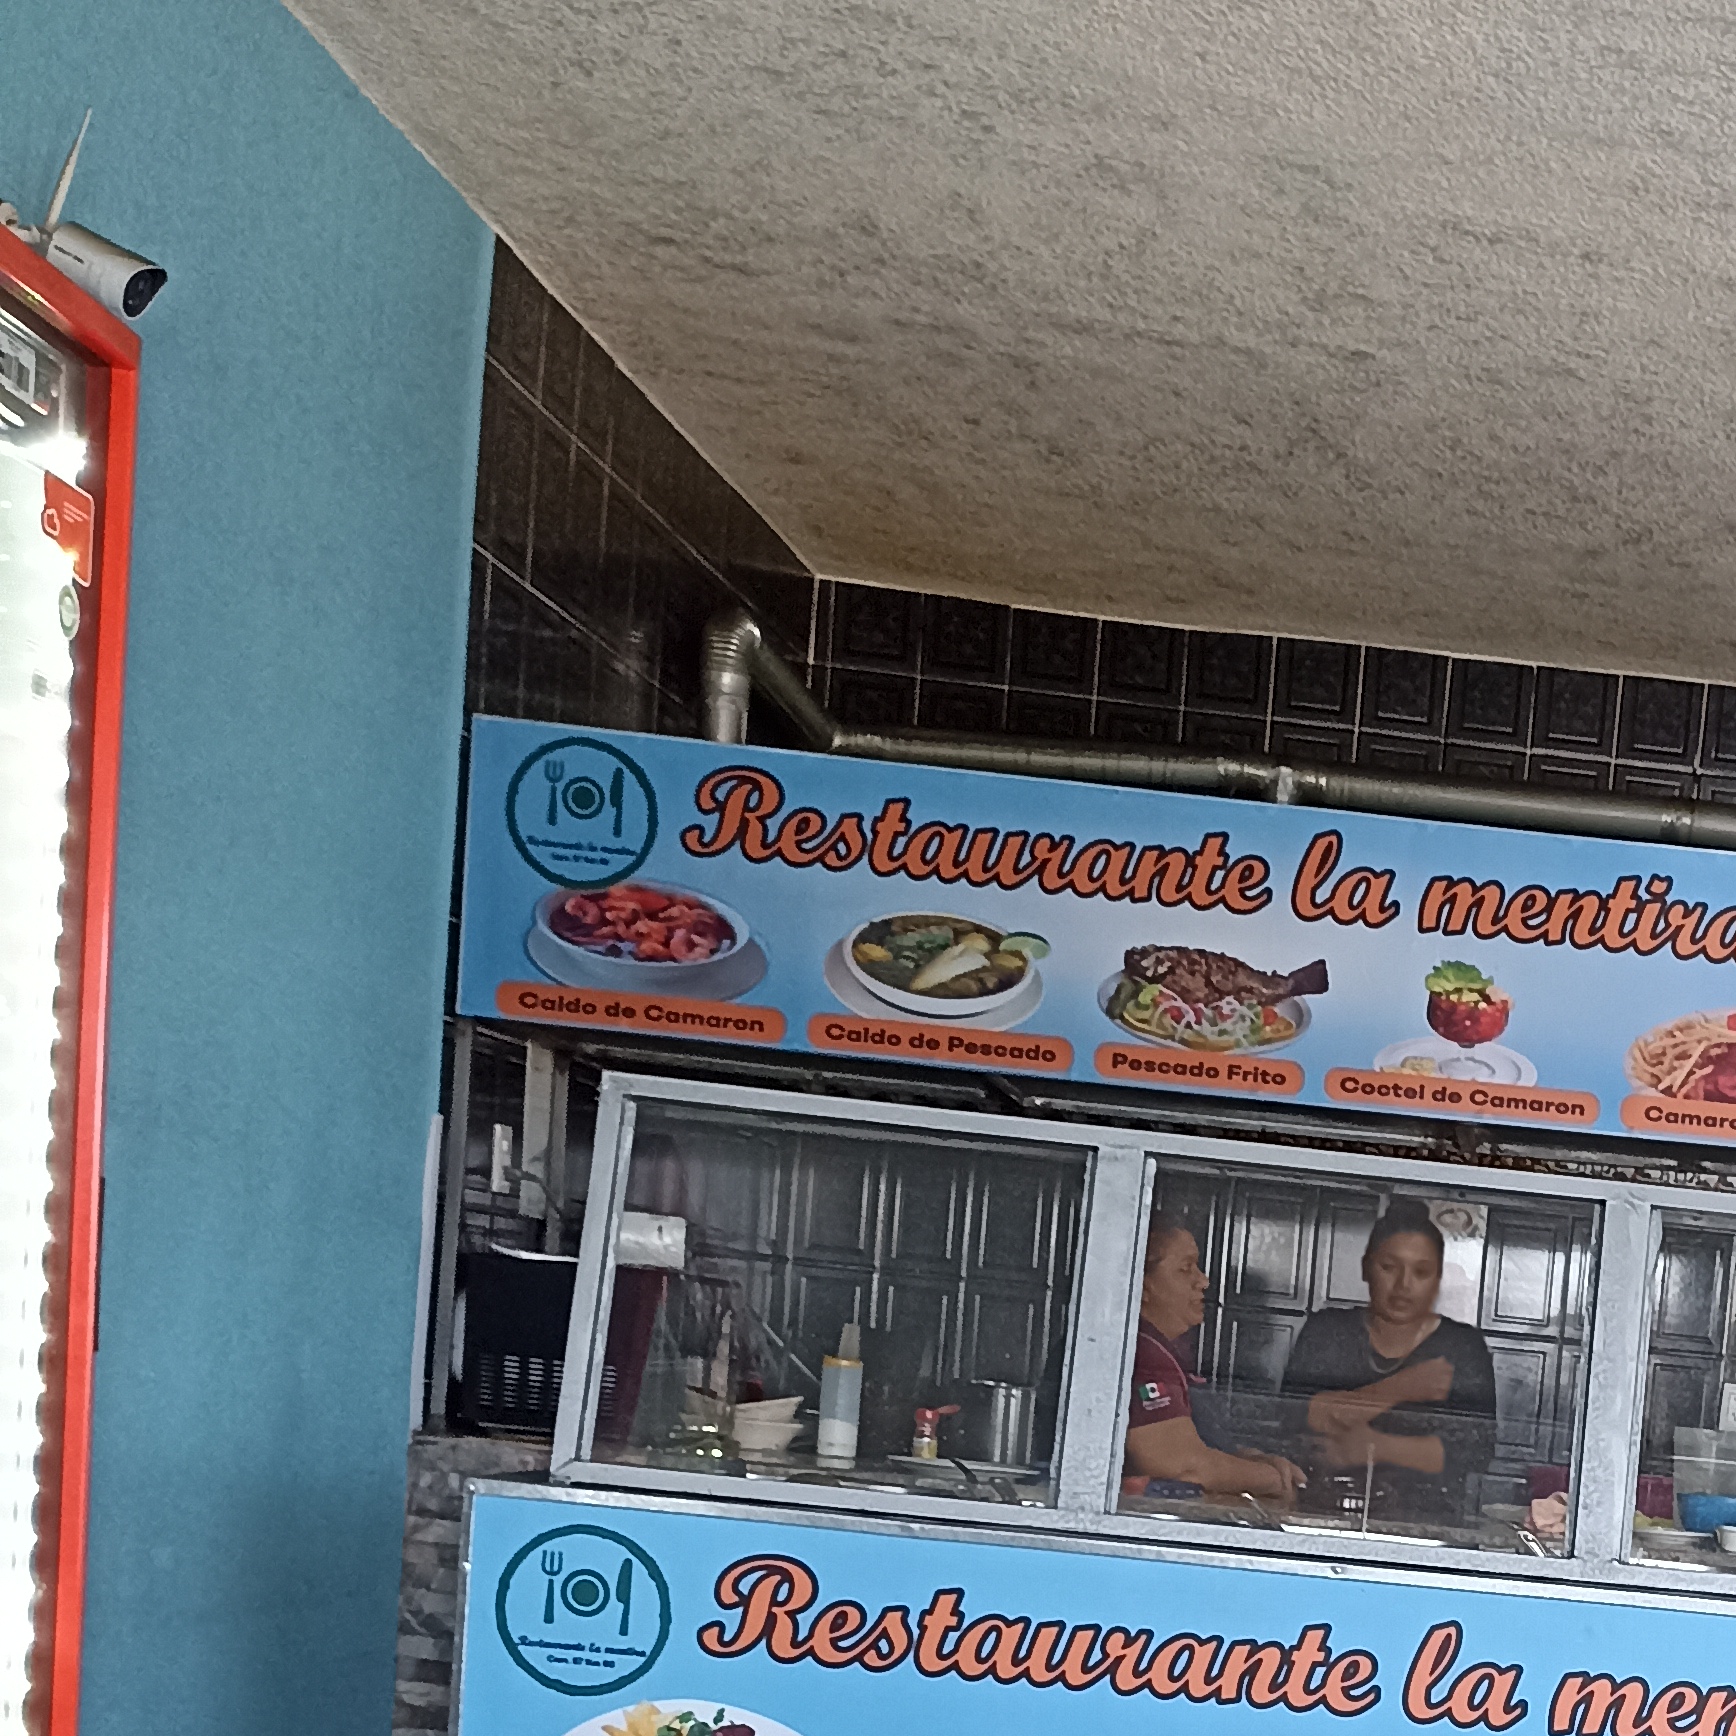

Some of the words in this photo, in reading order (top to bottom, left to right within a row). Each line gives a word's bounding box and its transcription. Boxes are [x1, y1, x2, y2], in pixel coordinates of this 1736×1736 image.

[681, 765, 1271, 914] Restaurante
[1292, 829, 1400, 929] la
[518, 992, 597, 1016] Caldo
[604, 1002, 637, 1019] de
[644, 1005, 765, 1033] Camaron
[825, 1023, 901, 1047] Caldo
[908, 1033, 941, 1051] de
[948, 1036, 1057, 1063] Pescado
[1112, 1052, 1220, 1079] Pescado
[1227, 1064, 1287, 1086] Frito
[1340, 1076, 1425, 1100] Coctel
[1431, 1086, 1462, 1104] de
[1469, 1089, 1586, 1116] Camaron
[698, 1553, 1381, 1718] Restaurante
[1401, 1620, 1527, 1731] la
